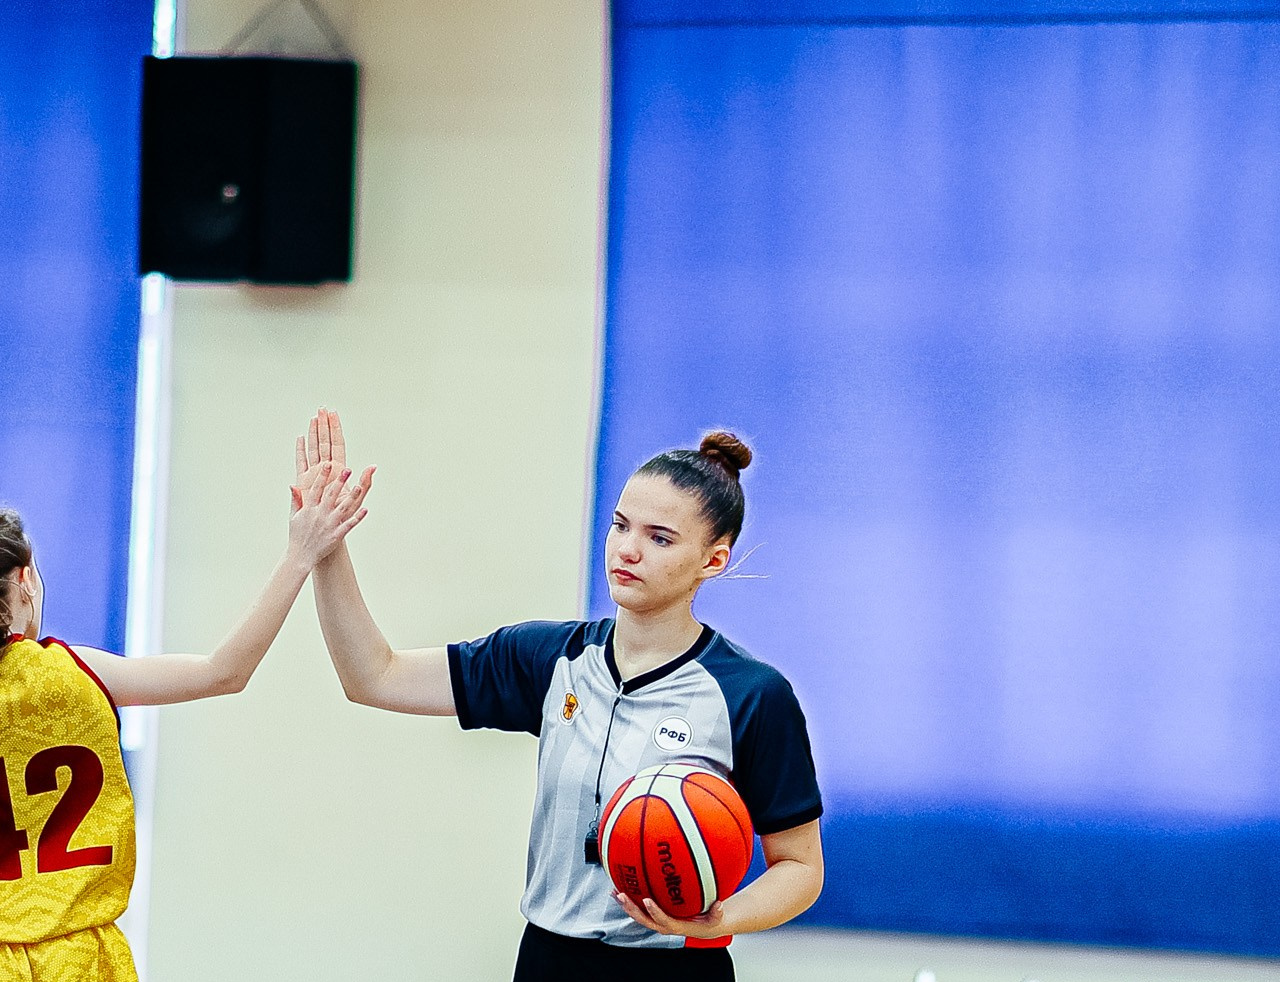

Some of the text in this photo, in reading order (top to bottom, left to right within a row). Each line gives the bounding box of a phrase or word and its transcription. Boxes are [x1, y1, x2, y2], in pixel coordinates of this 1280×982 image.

[659, 727, 688, 743] РФБ
[623, 865, 642, 896] FIBA
[657, 841, 685, 906] molten
